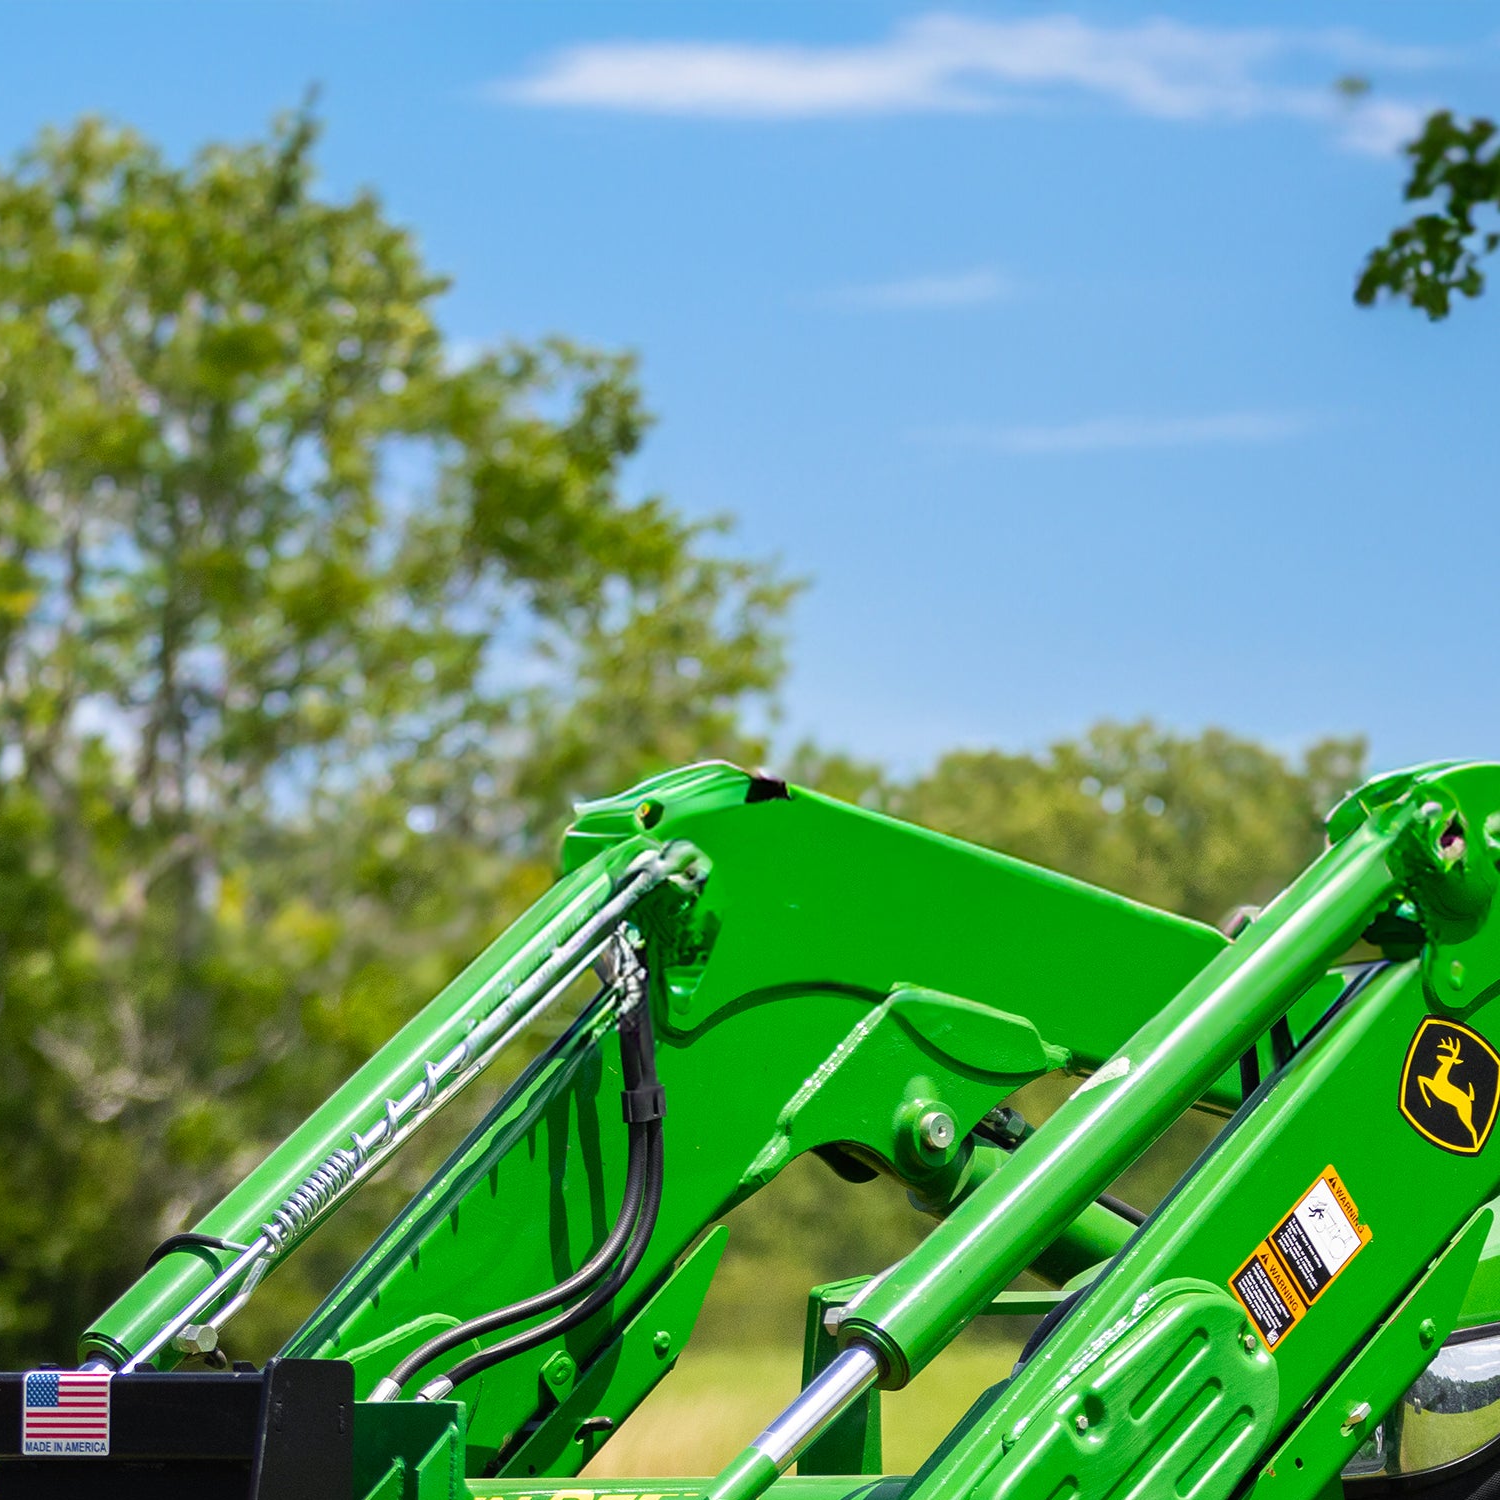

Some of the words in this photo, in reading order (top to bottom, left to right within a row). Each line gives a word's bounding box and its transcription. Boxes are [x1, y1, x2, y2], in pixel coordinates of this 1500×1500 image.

[1270, 1264, 1299, 1312] WARNING
[25, 1441, 52, 1453] MADE
[54, 1441, 63, 1453] IN
[64, 1441, 108, 1453] AMERICA
